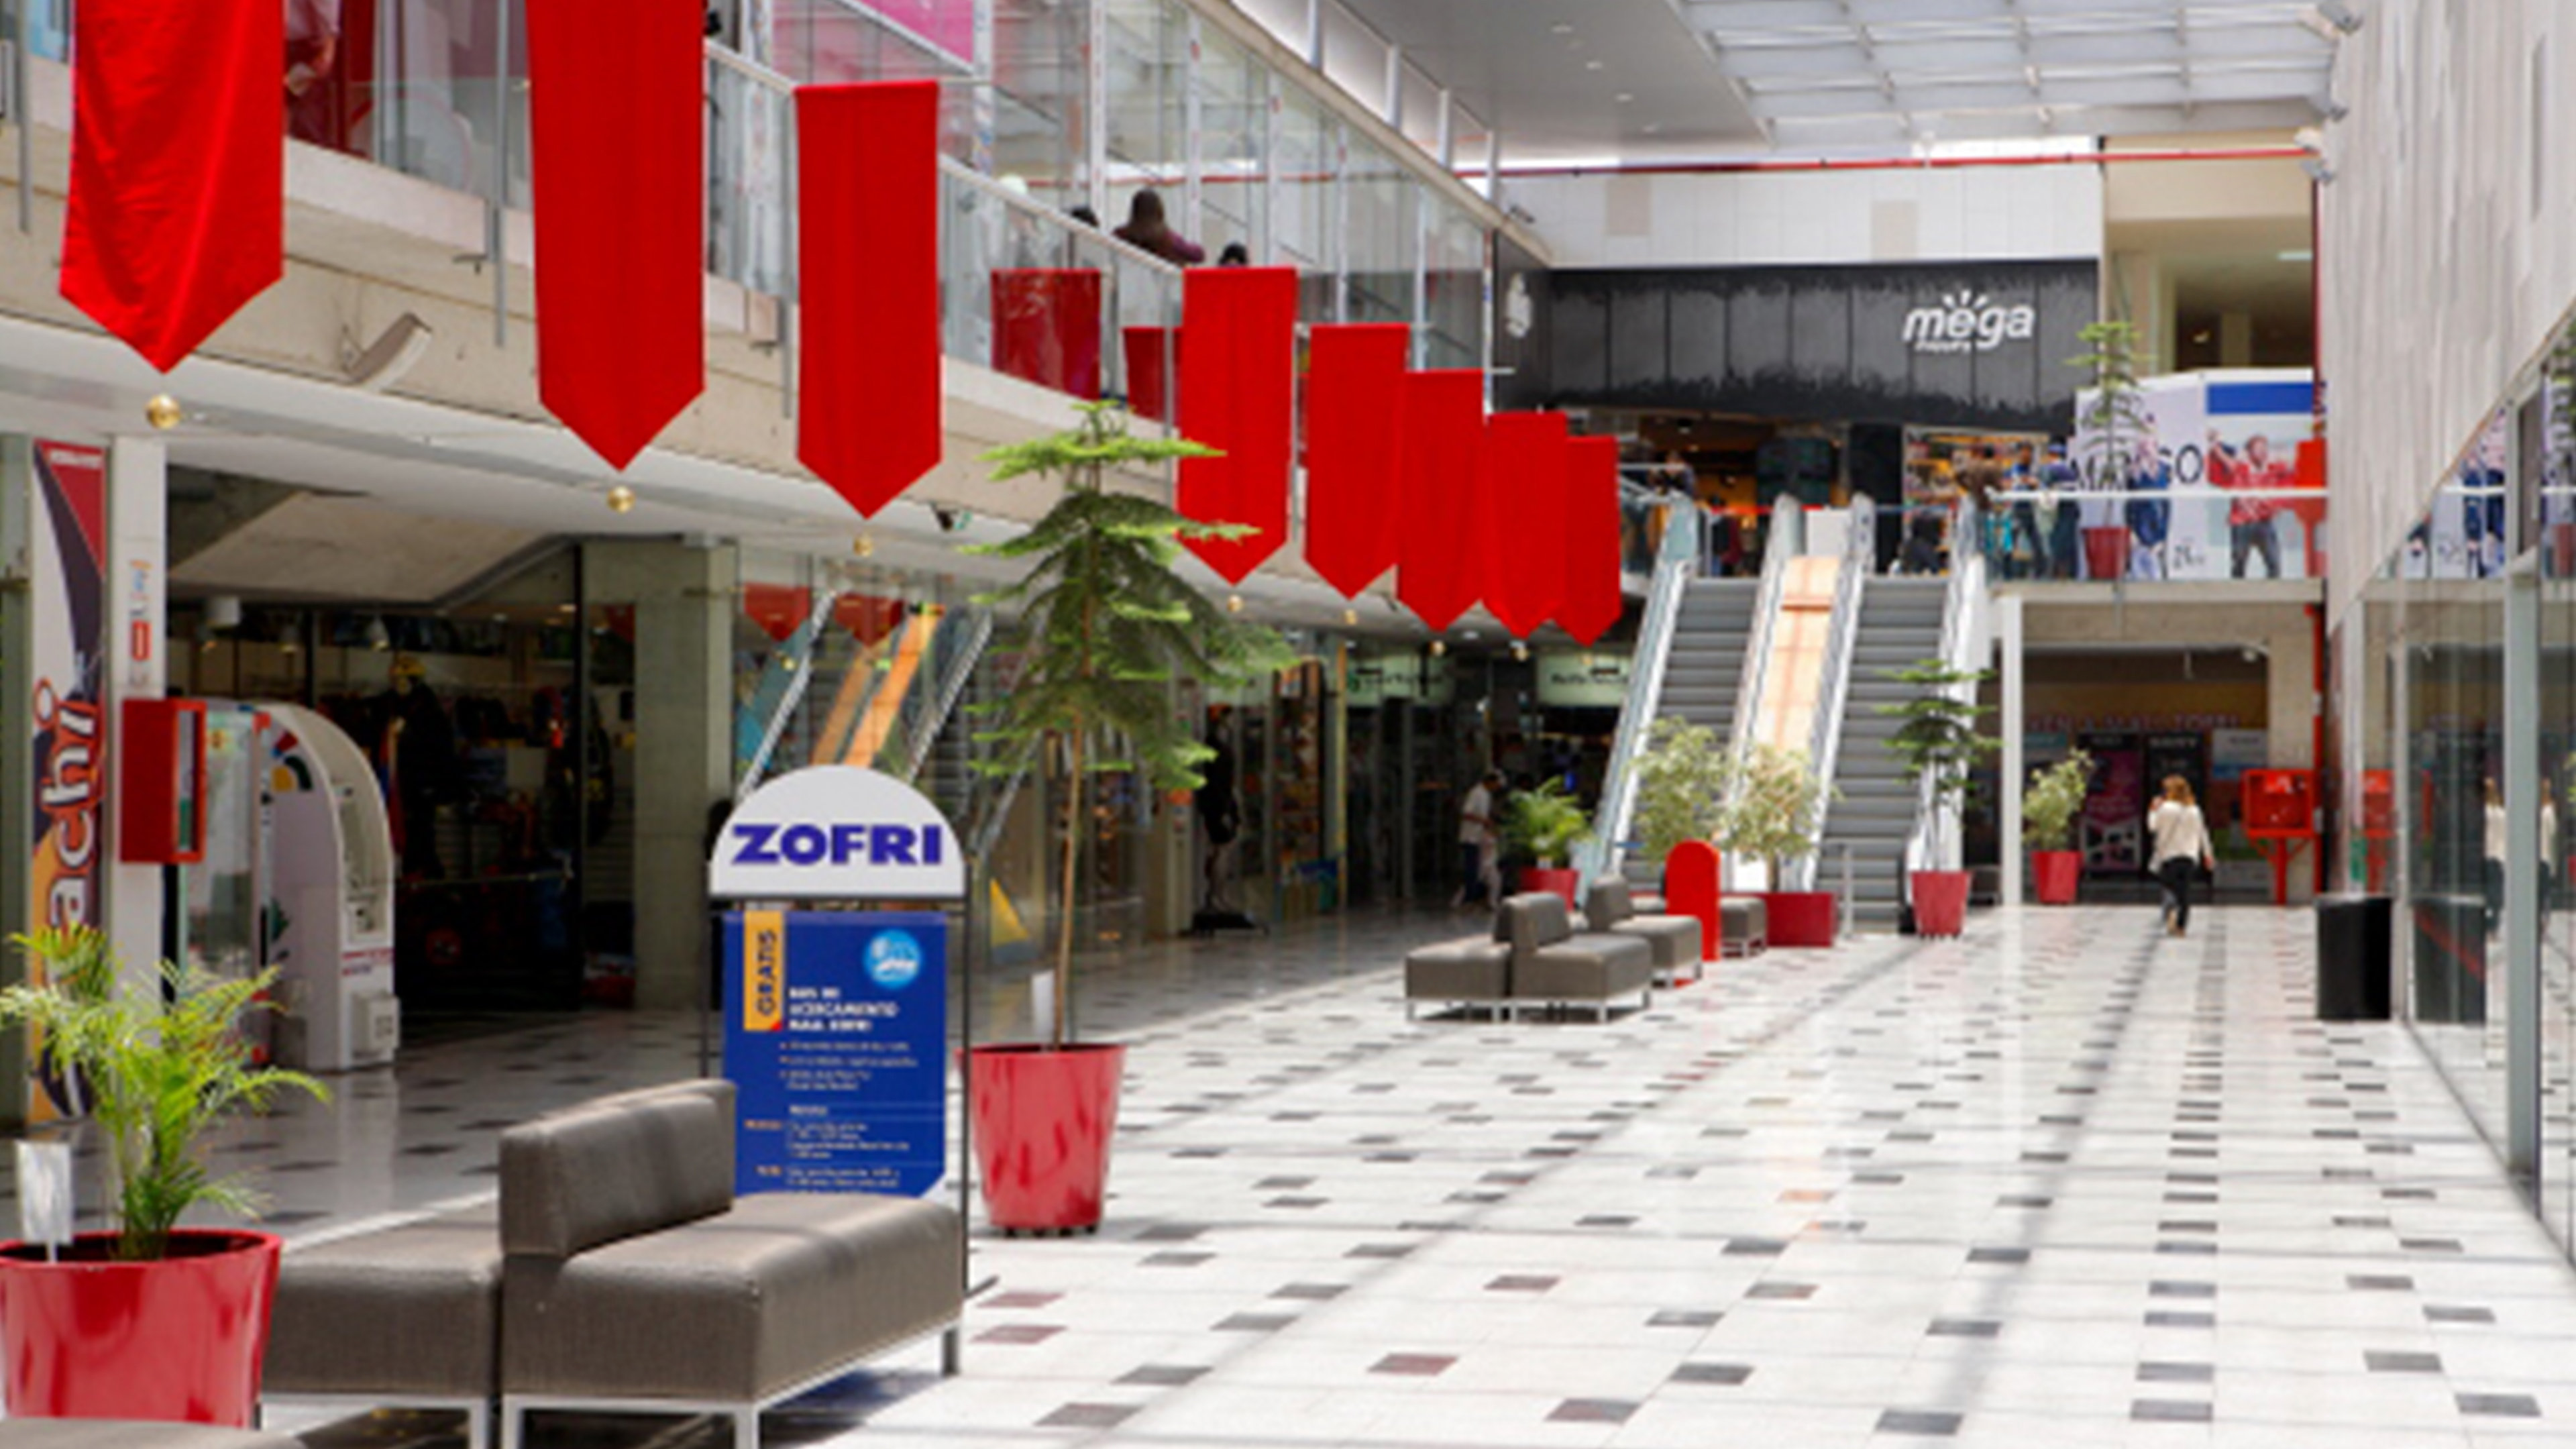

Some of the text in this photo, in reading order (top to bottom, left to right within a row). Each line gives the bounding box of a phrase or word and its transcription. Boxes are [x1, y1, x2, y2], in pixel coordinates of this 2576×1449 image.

[1902, 299, 2034, 350] mega
[33, 678, 96, 989] achi
[731, 823, 943, 865] ZOFRI
[756, 928, 776, 1017] GRATIS
